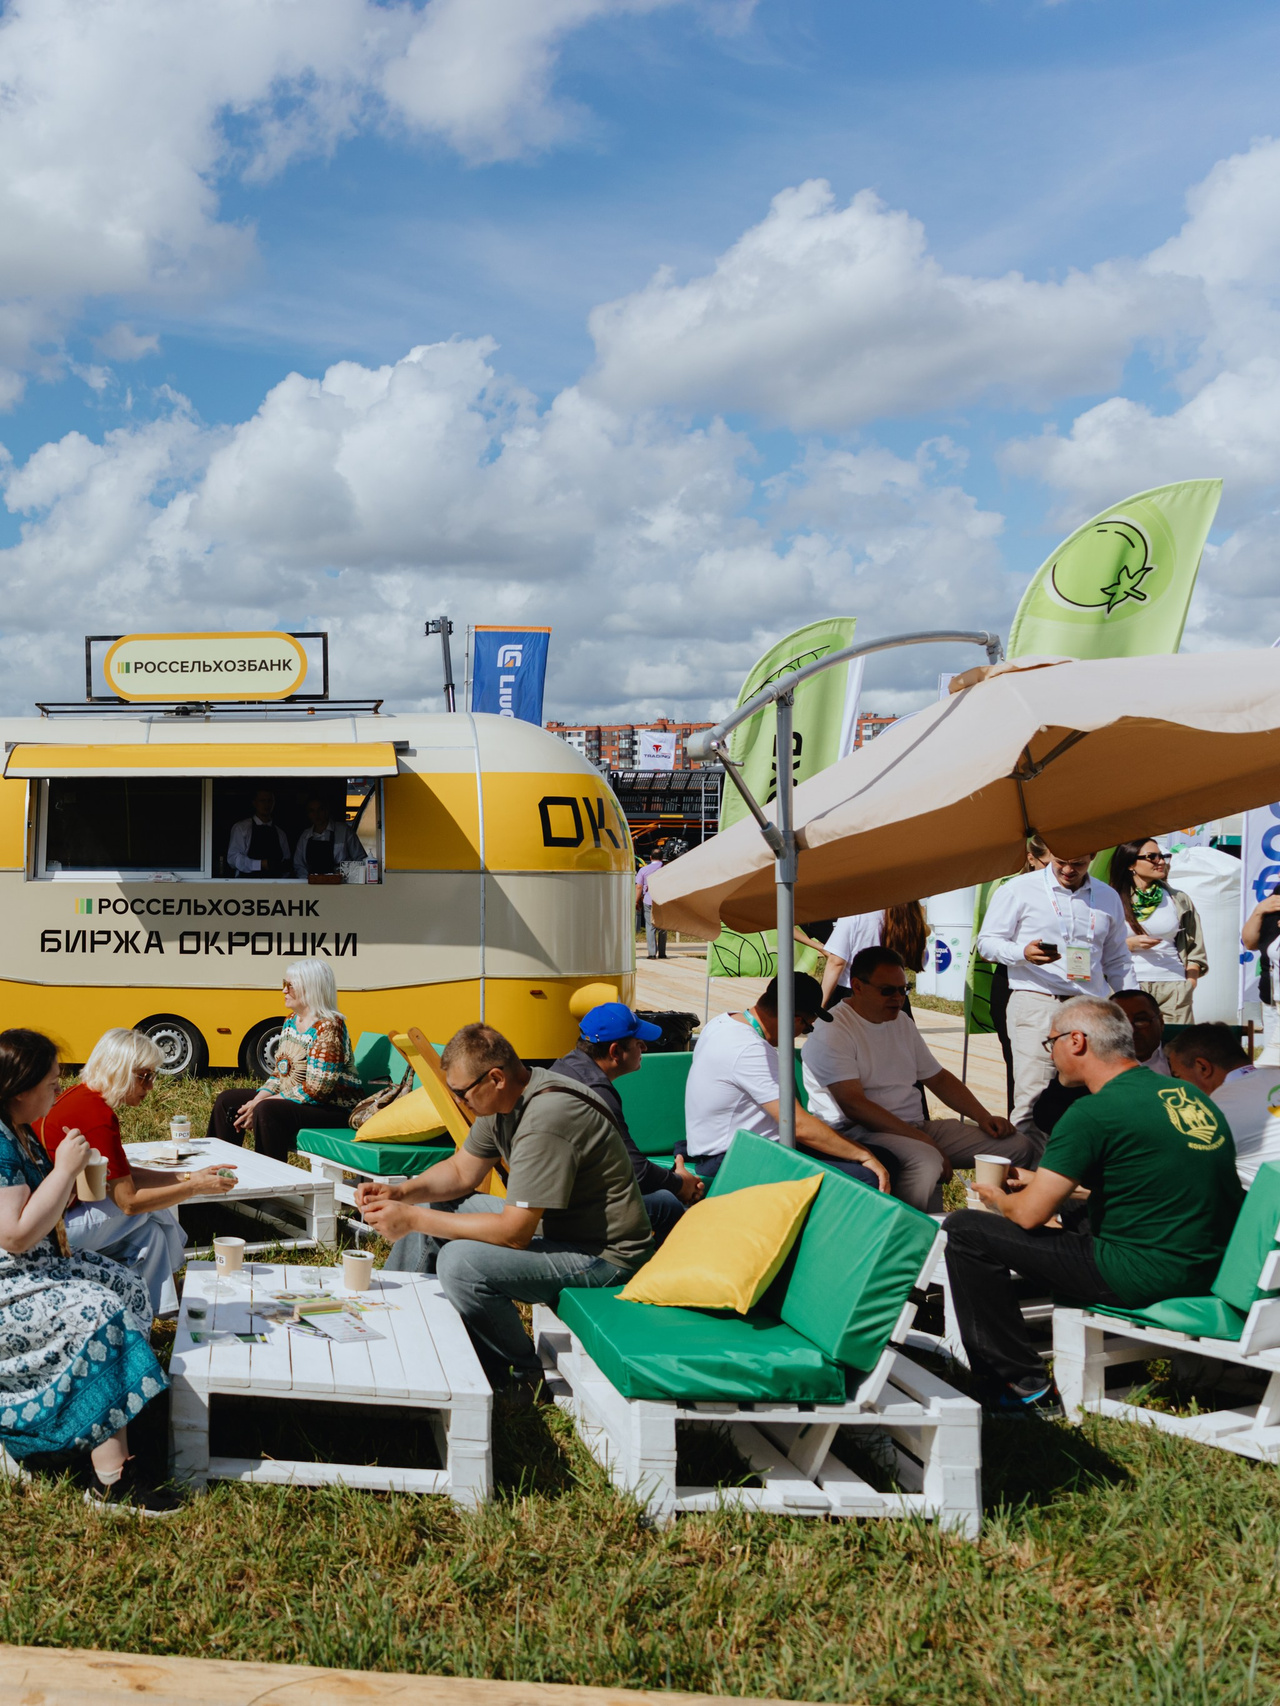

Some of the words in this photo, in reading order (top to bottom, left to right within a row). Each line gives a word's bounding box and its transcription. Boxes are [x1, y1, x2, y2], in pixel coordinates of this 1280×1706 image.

[134, 659, 293, 674] РОССЕЛЬХОЗБАНК
[98, 898, 320, 917] РОССЕЛЬХОЗБАНК
[40, 929, 165, 955] БИРЖА
[179, 930, 358, 957] ОКРОШКИ
